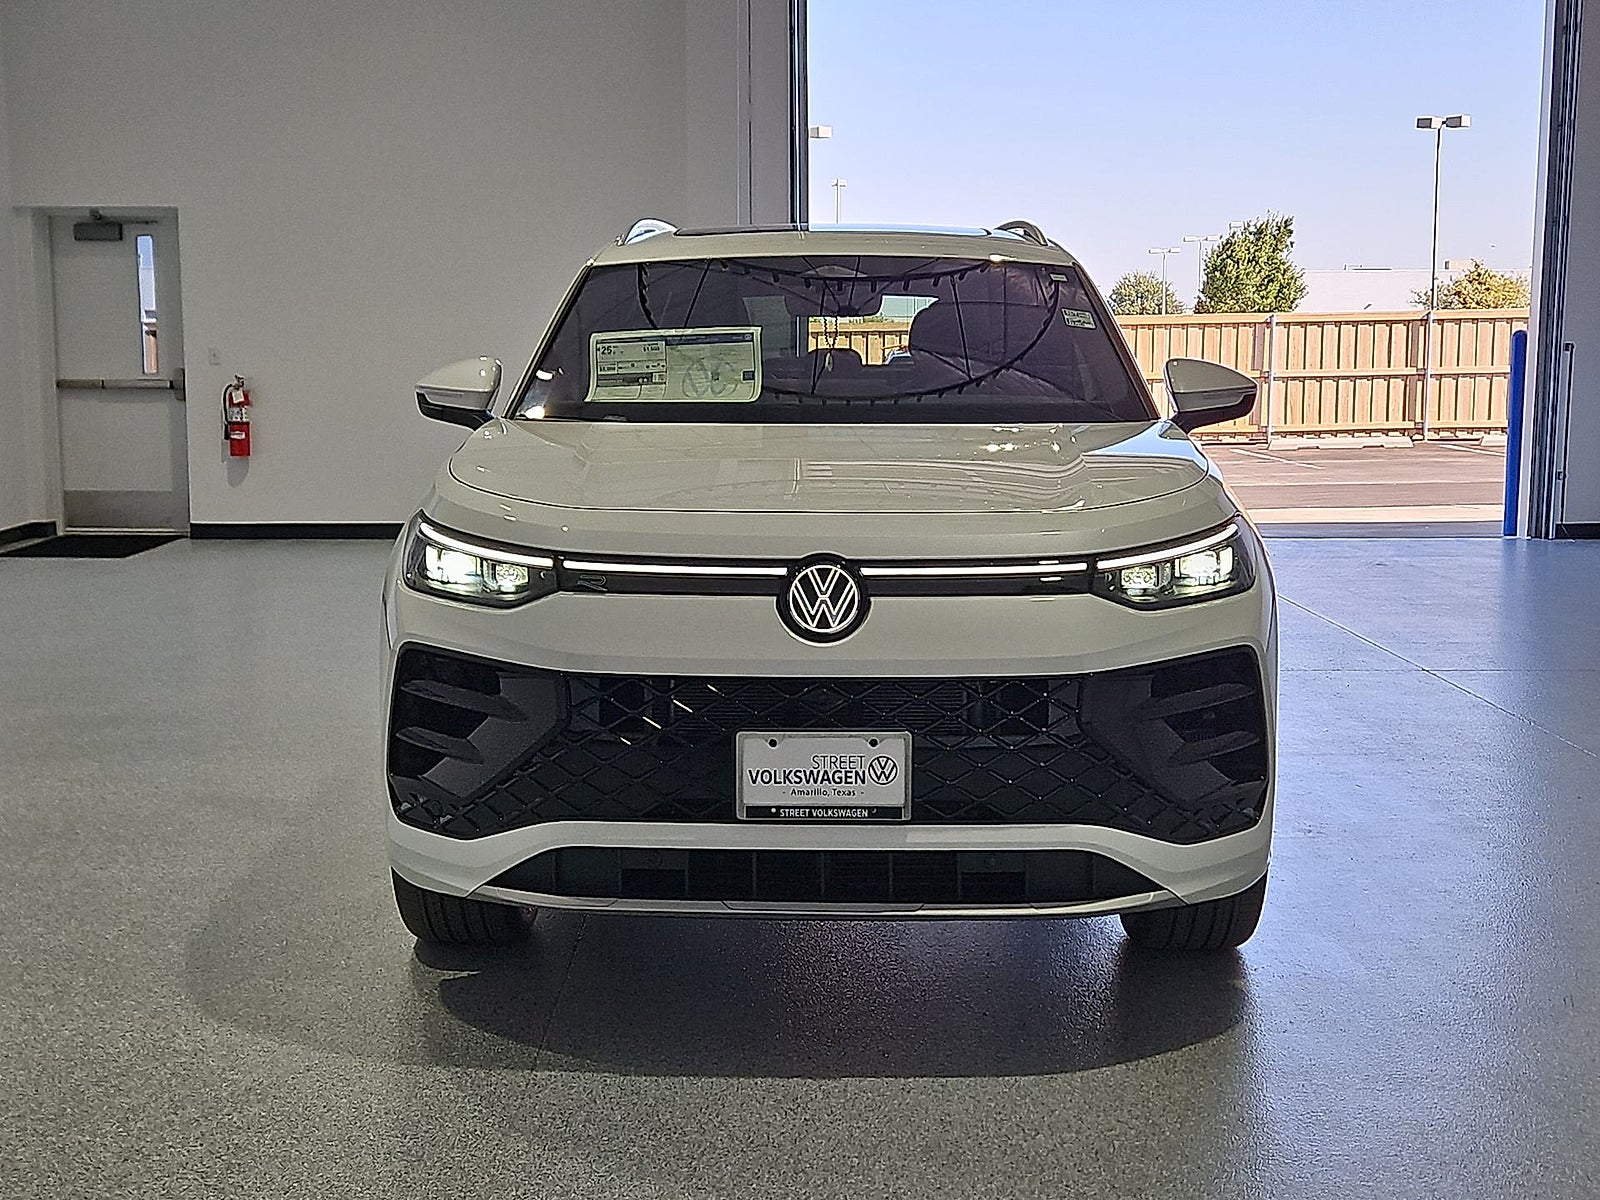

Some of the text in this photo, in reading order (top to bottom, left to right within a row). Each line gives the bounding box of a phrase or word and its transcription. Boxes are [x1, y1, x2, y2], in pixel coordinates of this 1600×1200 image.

[811, 755, 865, 769] STREET
[749, 770, 866, 785] VOLKSWAGEN
[790, 788, 856, 798] Amarillo, Texas
[780, 808, 868, 817] STREET VOLKSWAGEN
